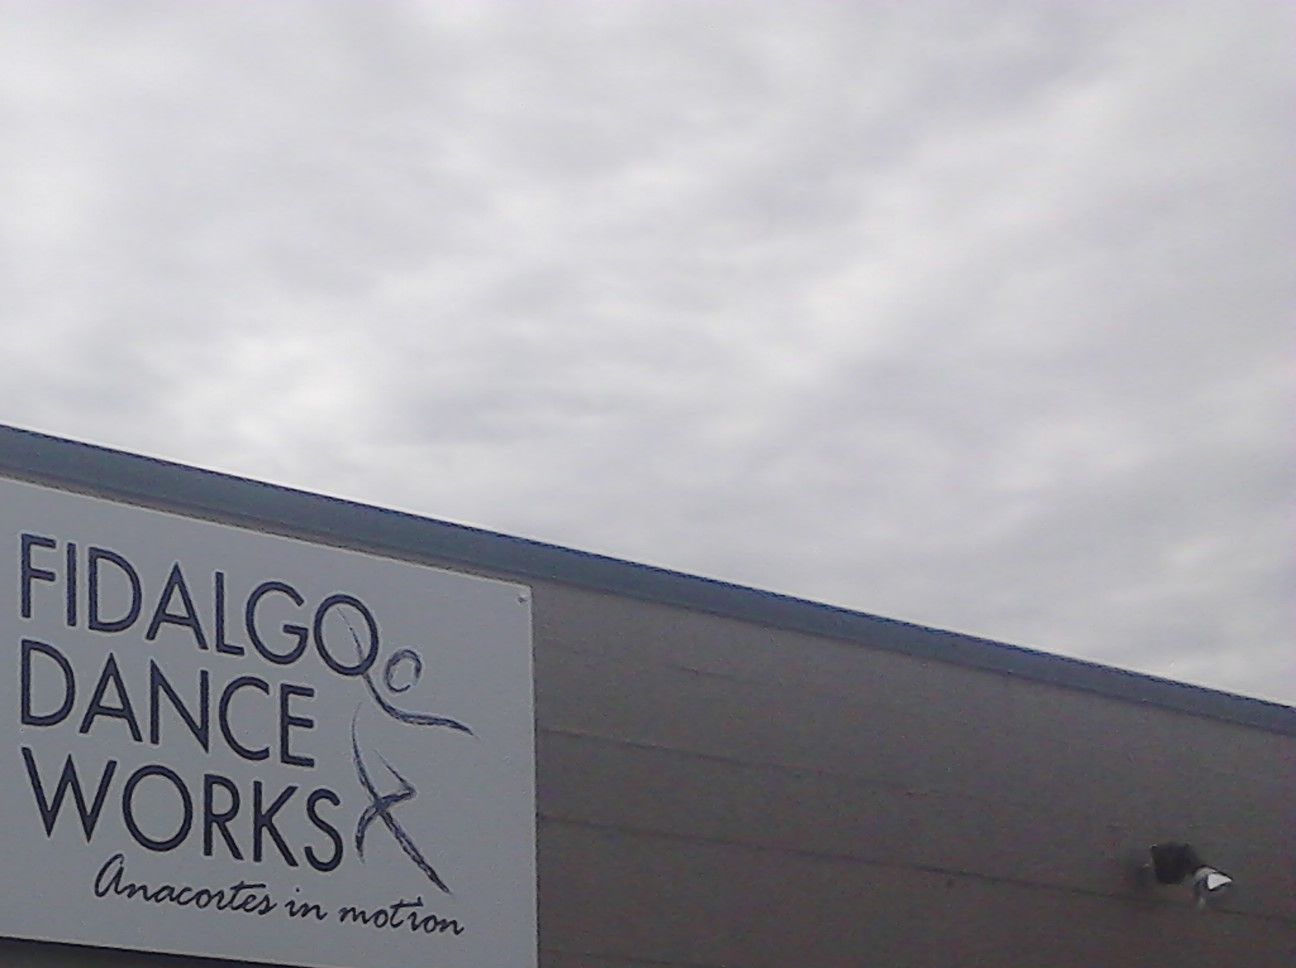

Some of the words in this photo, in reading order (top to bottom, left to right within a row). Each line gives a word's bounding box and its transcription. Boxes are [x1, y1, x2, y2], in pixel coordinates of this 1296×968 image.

[20, 533, 379, 676] FIDALGO
[20, 638, 315, 767] DANCE
[21, 746, 344, 872] WORKS
[94, 853, 277, 916] Anacortes
[284, 887, 328, 921] in
[338, 896, 465, 936] motion
